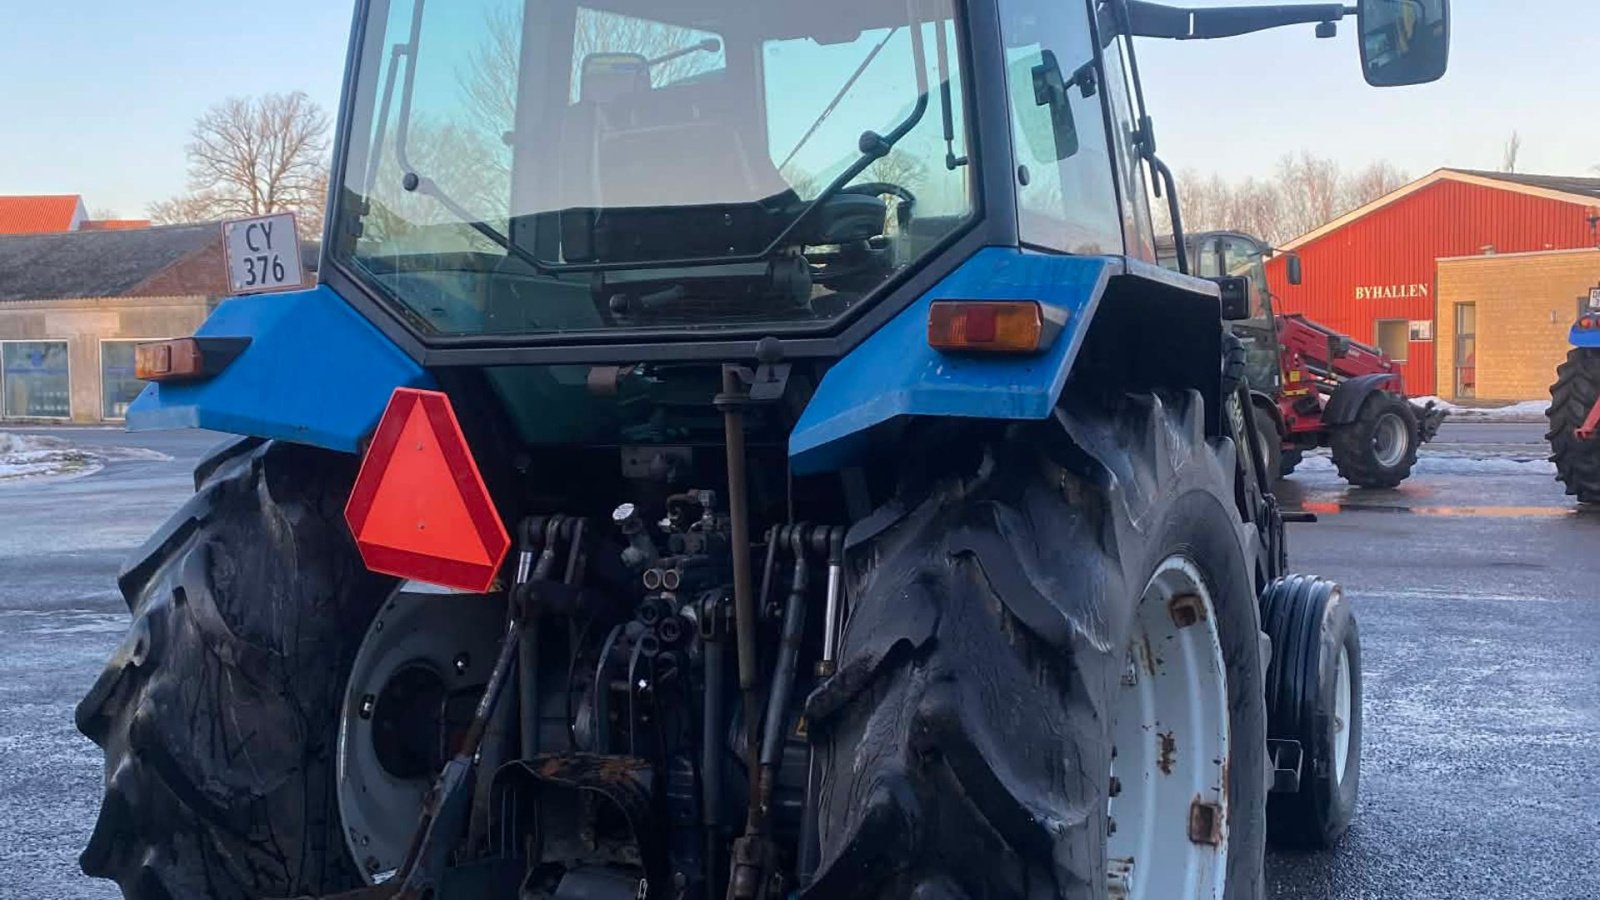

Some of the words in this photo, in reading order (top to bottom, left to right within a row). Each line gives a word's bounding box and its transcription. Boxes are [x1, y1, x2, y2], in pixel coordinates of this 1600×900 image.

[245, 221, 273, 252] CY
[243, 254, 285, 286] 376
[1355, 283, 1429, 300] BYHALLEN
